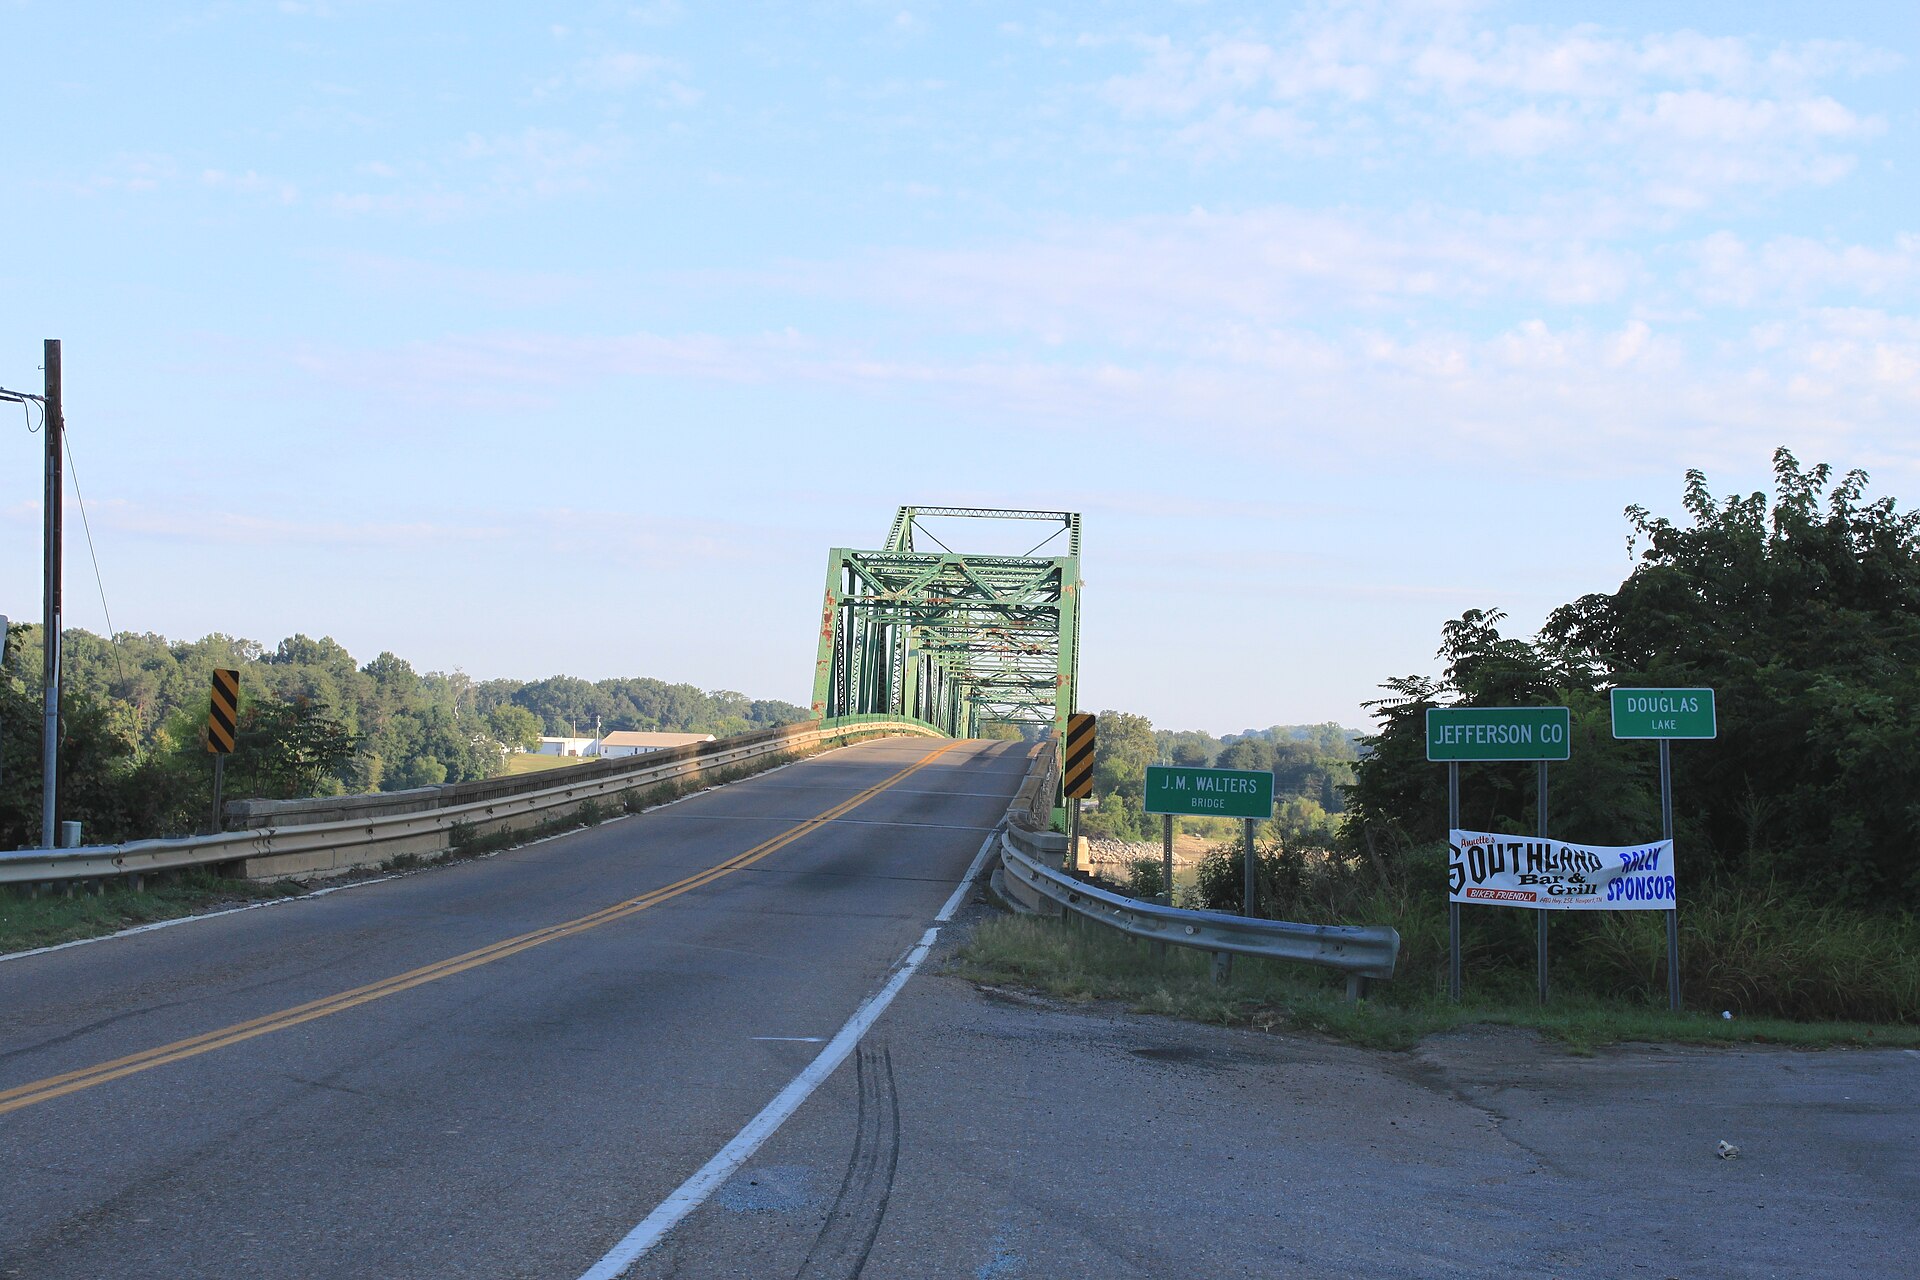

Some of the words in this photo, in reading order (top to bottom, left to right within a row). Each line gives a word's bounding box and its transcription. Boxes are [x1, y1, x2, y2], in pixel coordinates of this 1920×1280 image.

[1627, 697, 1699, 713] DOUGLAS
[1651, 719, 1677, 730] LAKE
[1434, 724, 1532, 745] JEFFERSON
[1540, 723, 1563, 744] CO
[1161, 775, 1191, 791] J.M.
[1196, 776, 1257, 794] WALTERS
[1191, 797, 1225, 809] BRIDGE
[1619, 847, 1661, 873] RALLY
[1518, 874, 1564, 886] Bar
[1568, 872, 1586, 884] &
[1470, 889, 1495, 899] BIKER
[1495, 892, 1534, 902] FRIENDLY
[1547, 884, 1597, 896] Grill
[1607, 875, 1675, 901] SPONSOR
